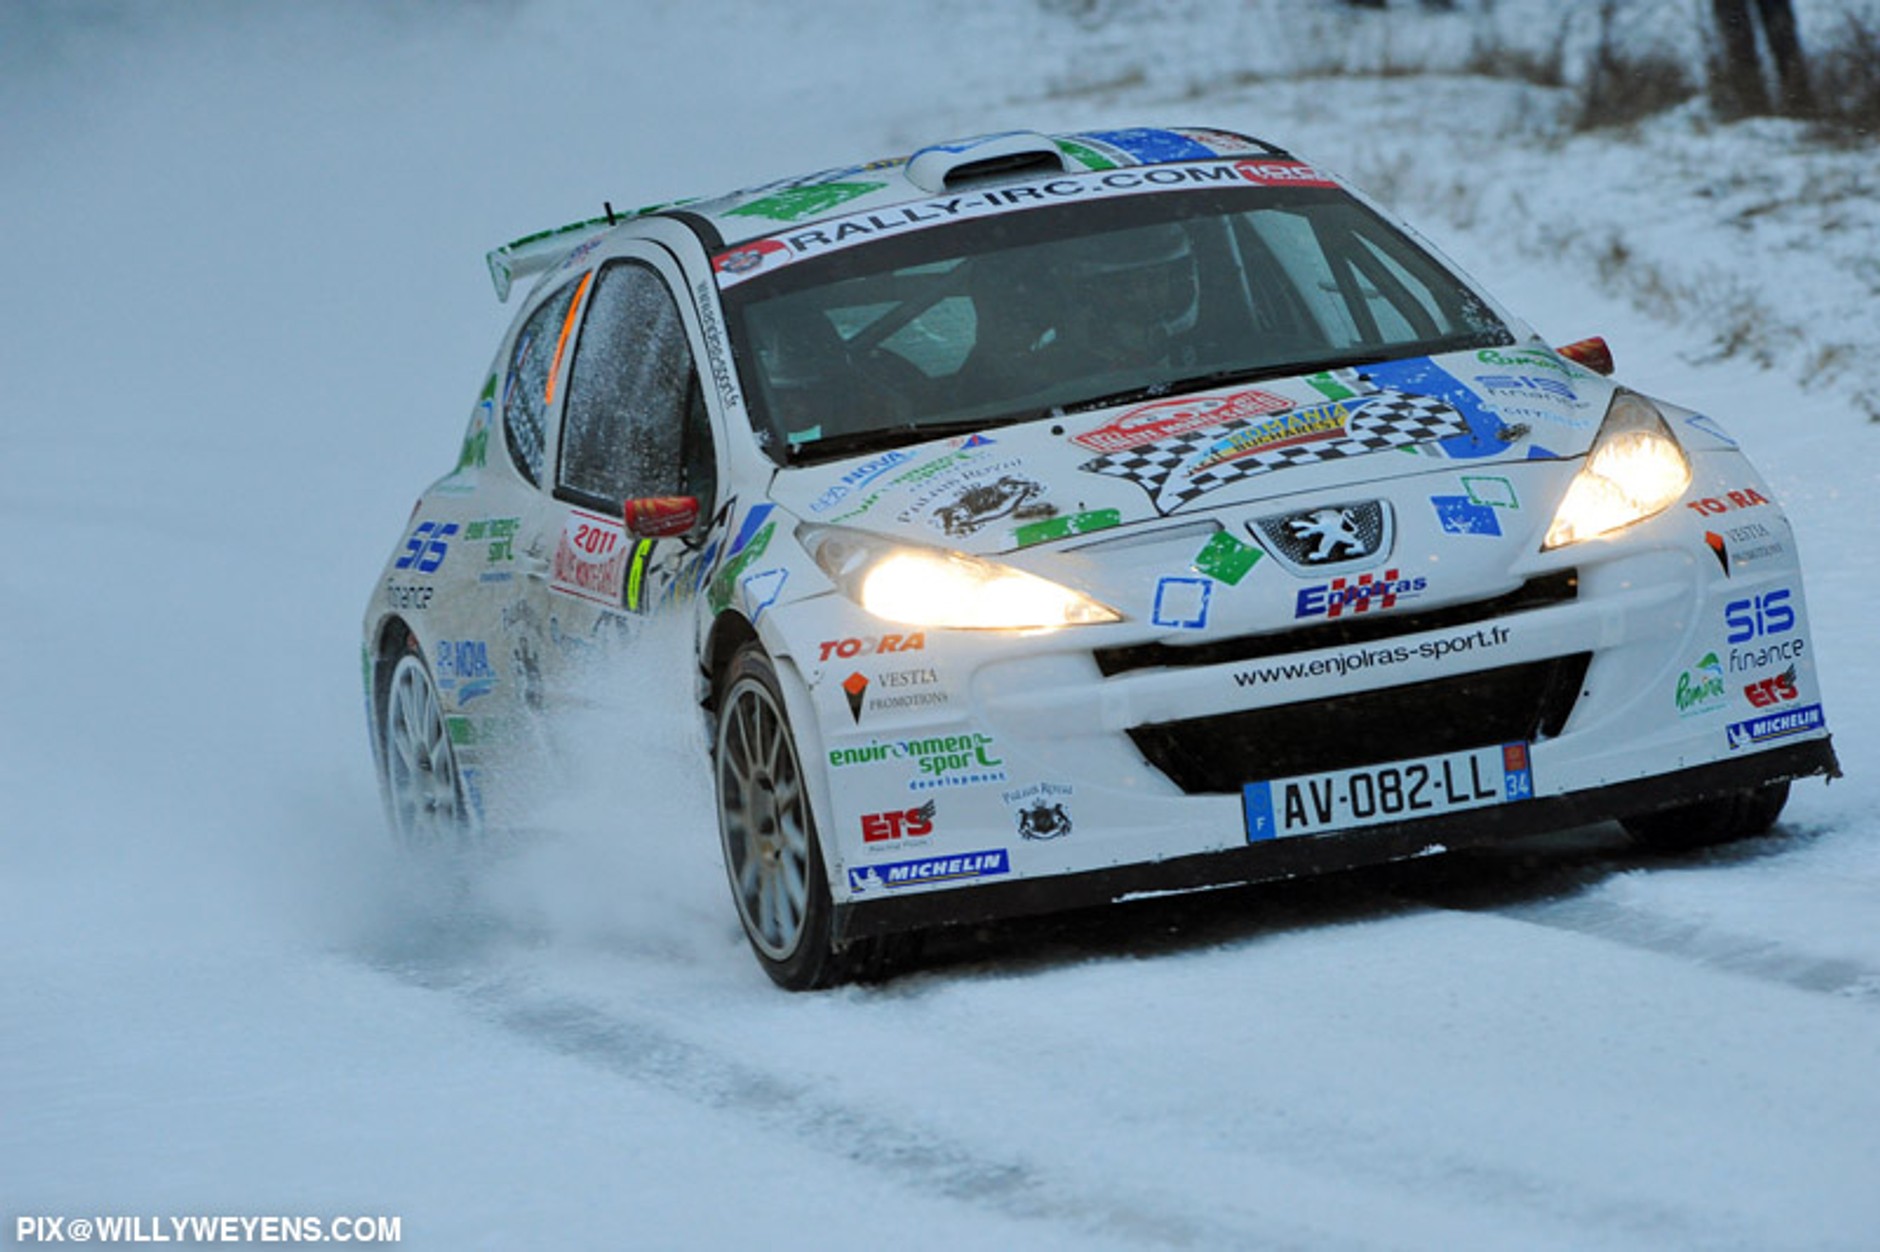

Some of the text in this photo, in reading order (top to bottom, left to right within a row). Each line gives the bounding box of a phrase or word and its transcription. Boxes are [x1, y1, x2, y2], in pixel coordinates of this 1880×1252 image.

[788, 164, 1240, 251] RALLY-IRC.COM
[1228, 403, 1349, 445] ROMANIA
[573, 523, 617, 554] 2011
[1233, 625, 1511, 687] www.enjolras-sport.fr
[1730, 639, 1804, 672] finance
[878, 668, 938, 687] VESTIA
[1744, 674, 1799, 708] ETS
[868, 692, 948, 710] PROMOTIONS
[1752, 708, 1819, 737] MICHELIN
[909, 773, 1005, 790] development
[1284, 755, 1496, 828] AV-082-LL
[1506, 774, 1529, 796] 34
[860, 807, 933, 842] ETS
[1257, 816, 1265, 830] F
[888, 854, 1000, 882] MICHELIN
